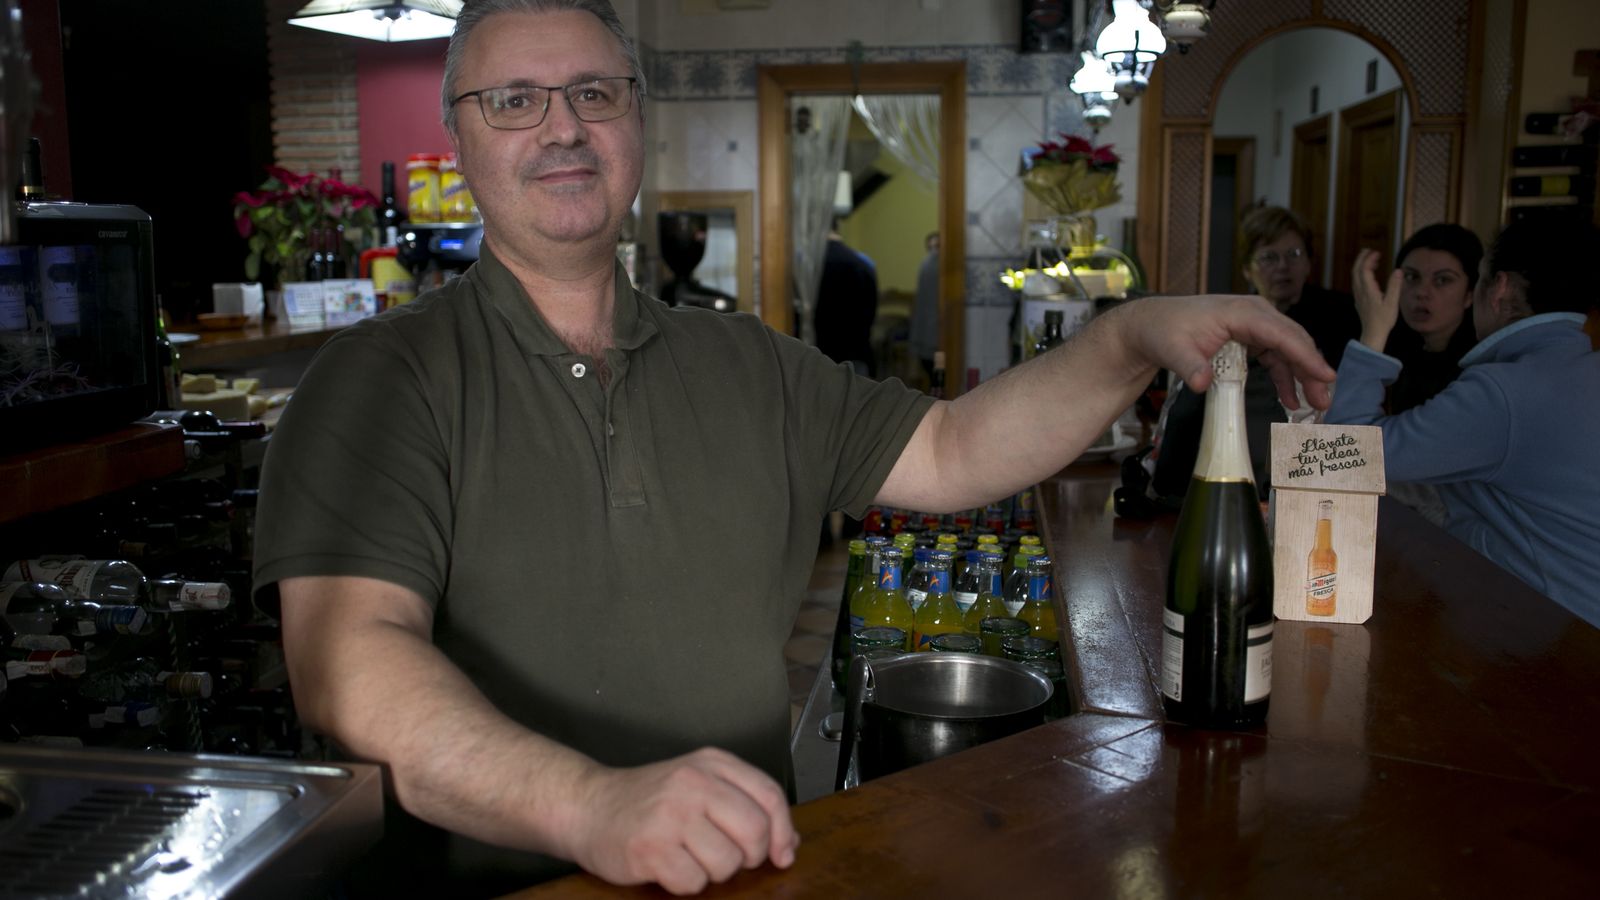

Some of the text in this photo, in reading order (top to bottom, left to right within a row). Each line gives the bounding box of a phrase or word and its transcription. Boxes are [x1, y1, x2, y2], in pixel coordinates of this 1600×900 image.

[1301, 433, 1357, 454] Llévate
[1292, 447, 1361, 465] tus ideas
[1288, 458, 1366, 479] más frescas
[1313, 587, 1335, 597] FRESCA
